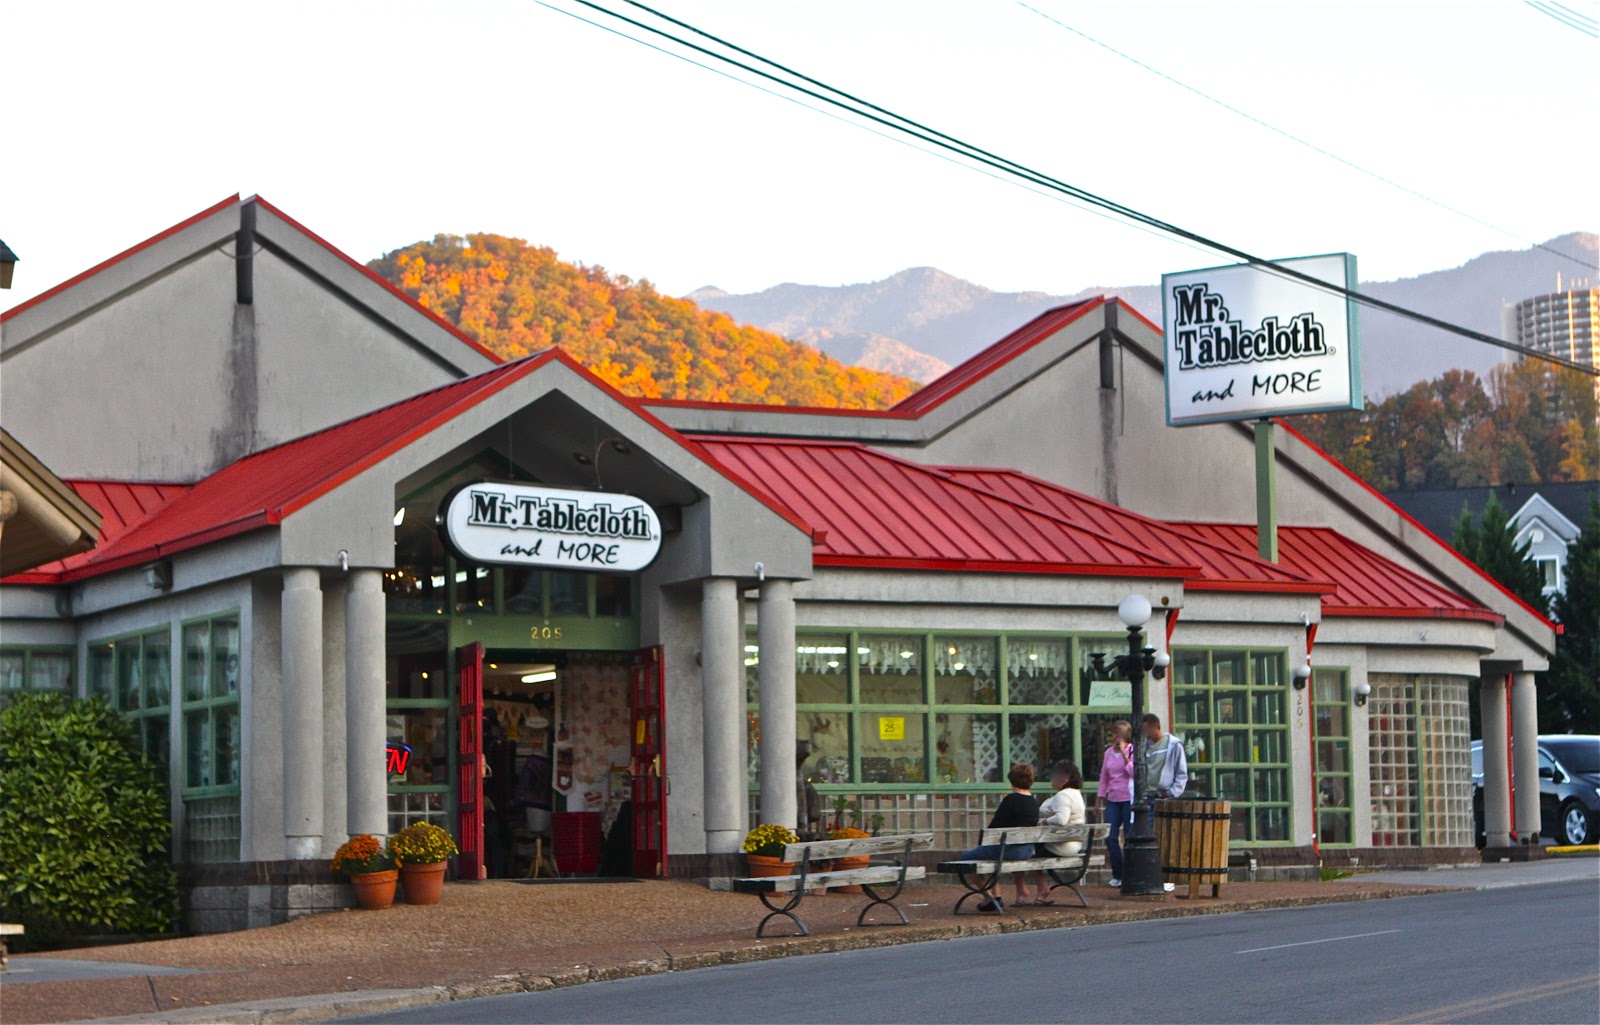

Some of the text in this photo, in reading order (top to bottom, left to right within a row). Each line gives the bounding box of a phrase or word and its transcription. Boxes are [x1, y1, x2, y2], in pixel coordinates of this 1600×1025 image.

[1177, 287, 1226, 327] Mr.
[1178, 317, 1323, 366] Tablecloth
[1191, 369, 1322, 403] and MORE
[499, 538, 621, 565] and MORE
[530, 626, 563, 640] 205
